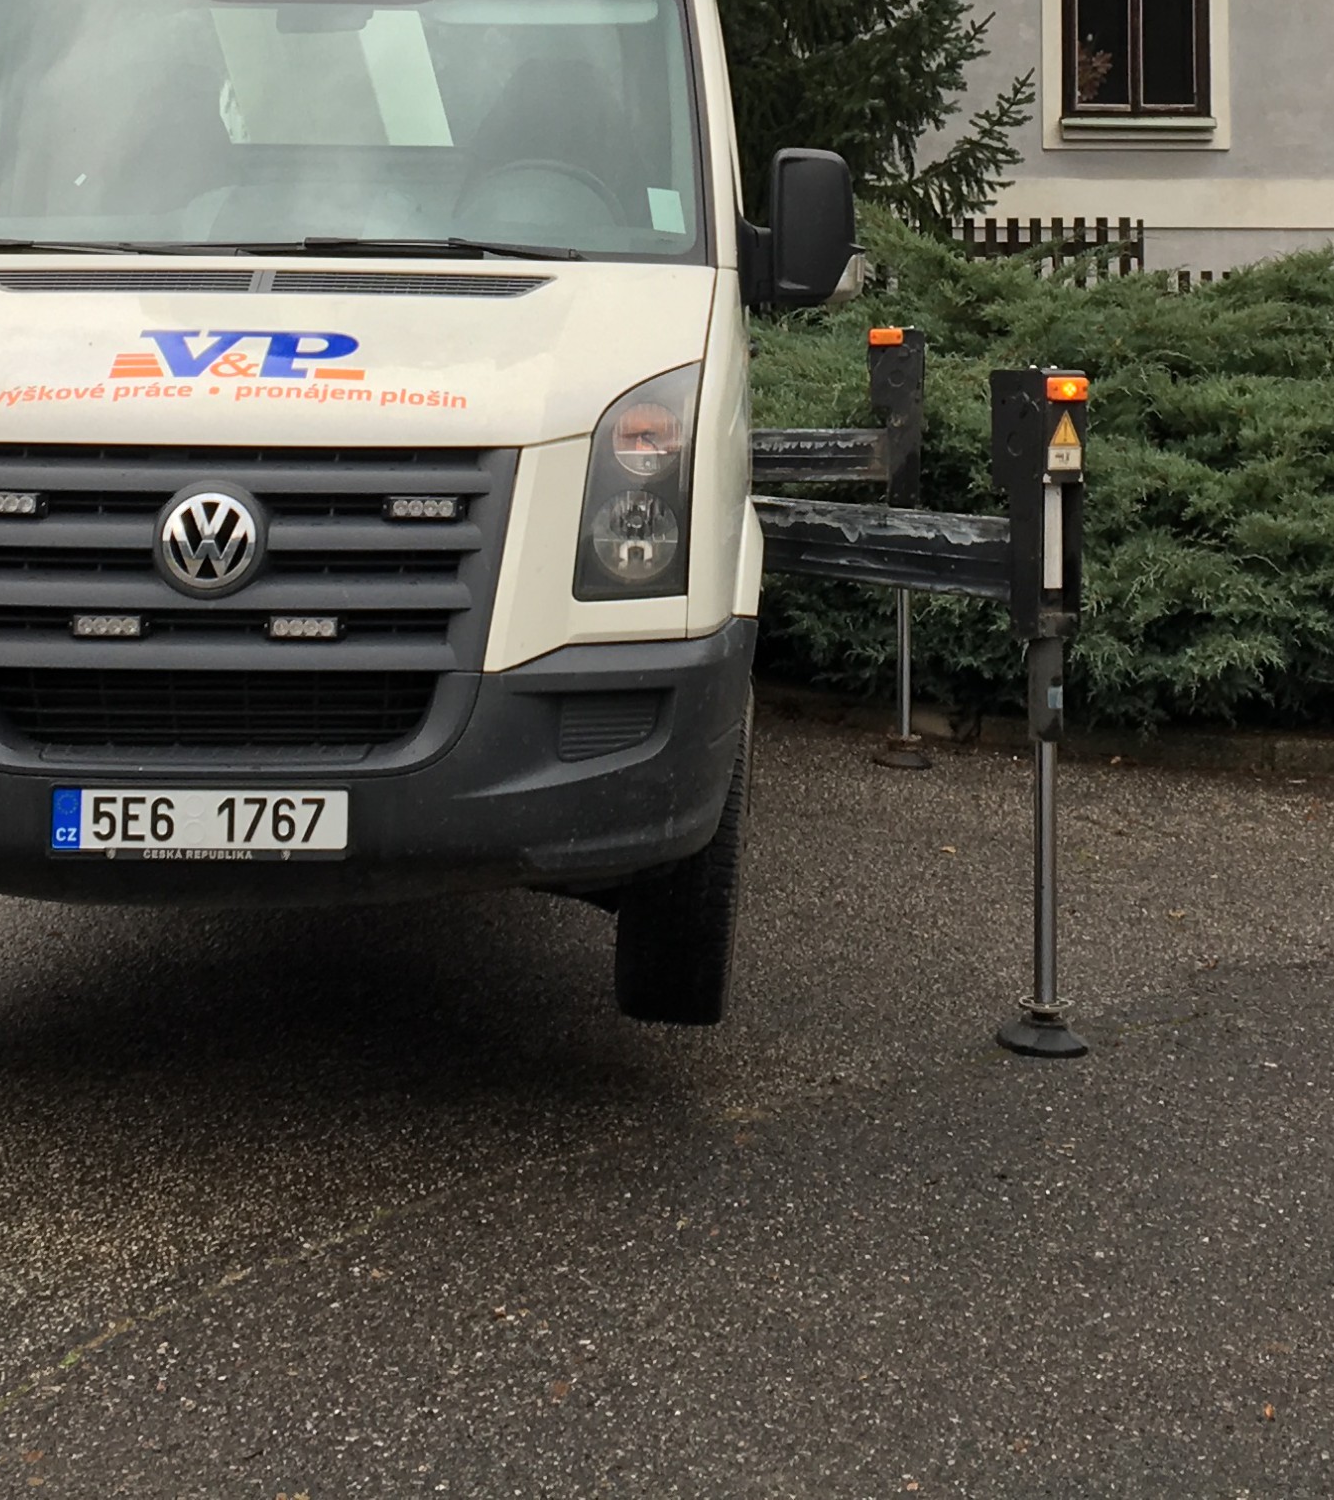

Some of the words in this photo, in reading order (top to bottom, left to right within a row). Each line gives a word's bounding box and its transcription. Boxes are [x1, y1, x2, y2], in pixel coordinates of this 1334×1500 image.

[140, 330, 359, 378] V&P
[113, 382, 193, 402] práce
[235, 384, 372, 404] pronájem
[380, 388, 468, 409] plošin
[55, 827, 78, 842] CZ
[92, 796, 175, 842] 5E6
[217, 797, 326, 843] 1767
[186, 850, 253, 860] REPUBLIKA
